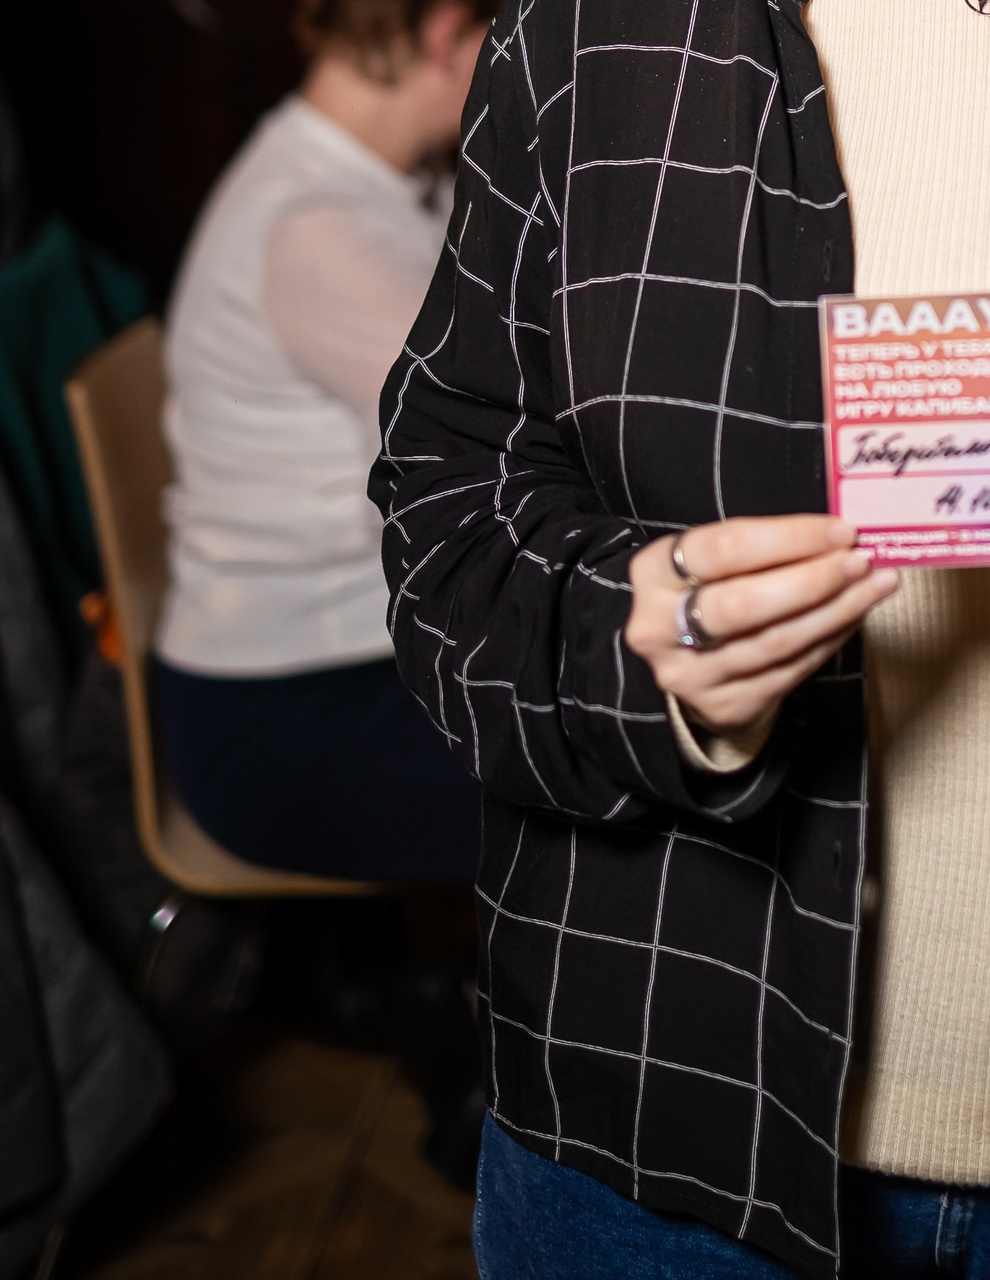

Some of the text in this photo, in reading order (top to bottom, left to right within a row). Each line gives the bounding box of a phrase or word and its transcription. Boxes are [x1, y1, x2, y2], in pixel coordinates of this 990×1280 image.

[834, 343, 920, 362] ТЕПЕРЬ
[921, 341, 939, 358] У
[834, 362, 893, 381] ЕСТЬ
[835, 378, 963, 400] НА ЛЮБУЮ
[835, 399, 894, 419] ИГРУ
